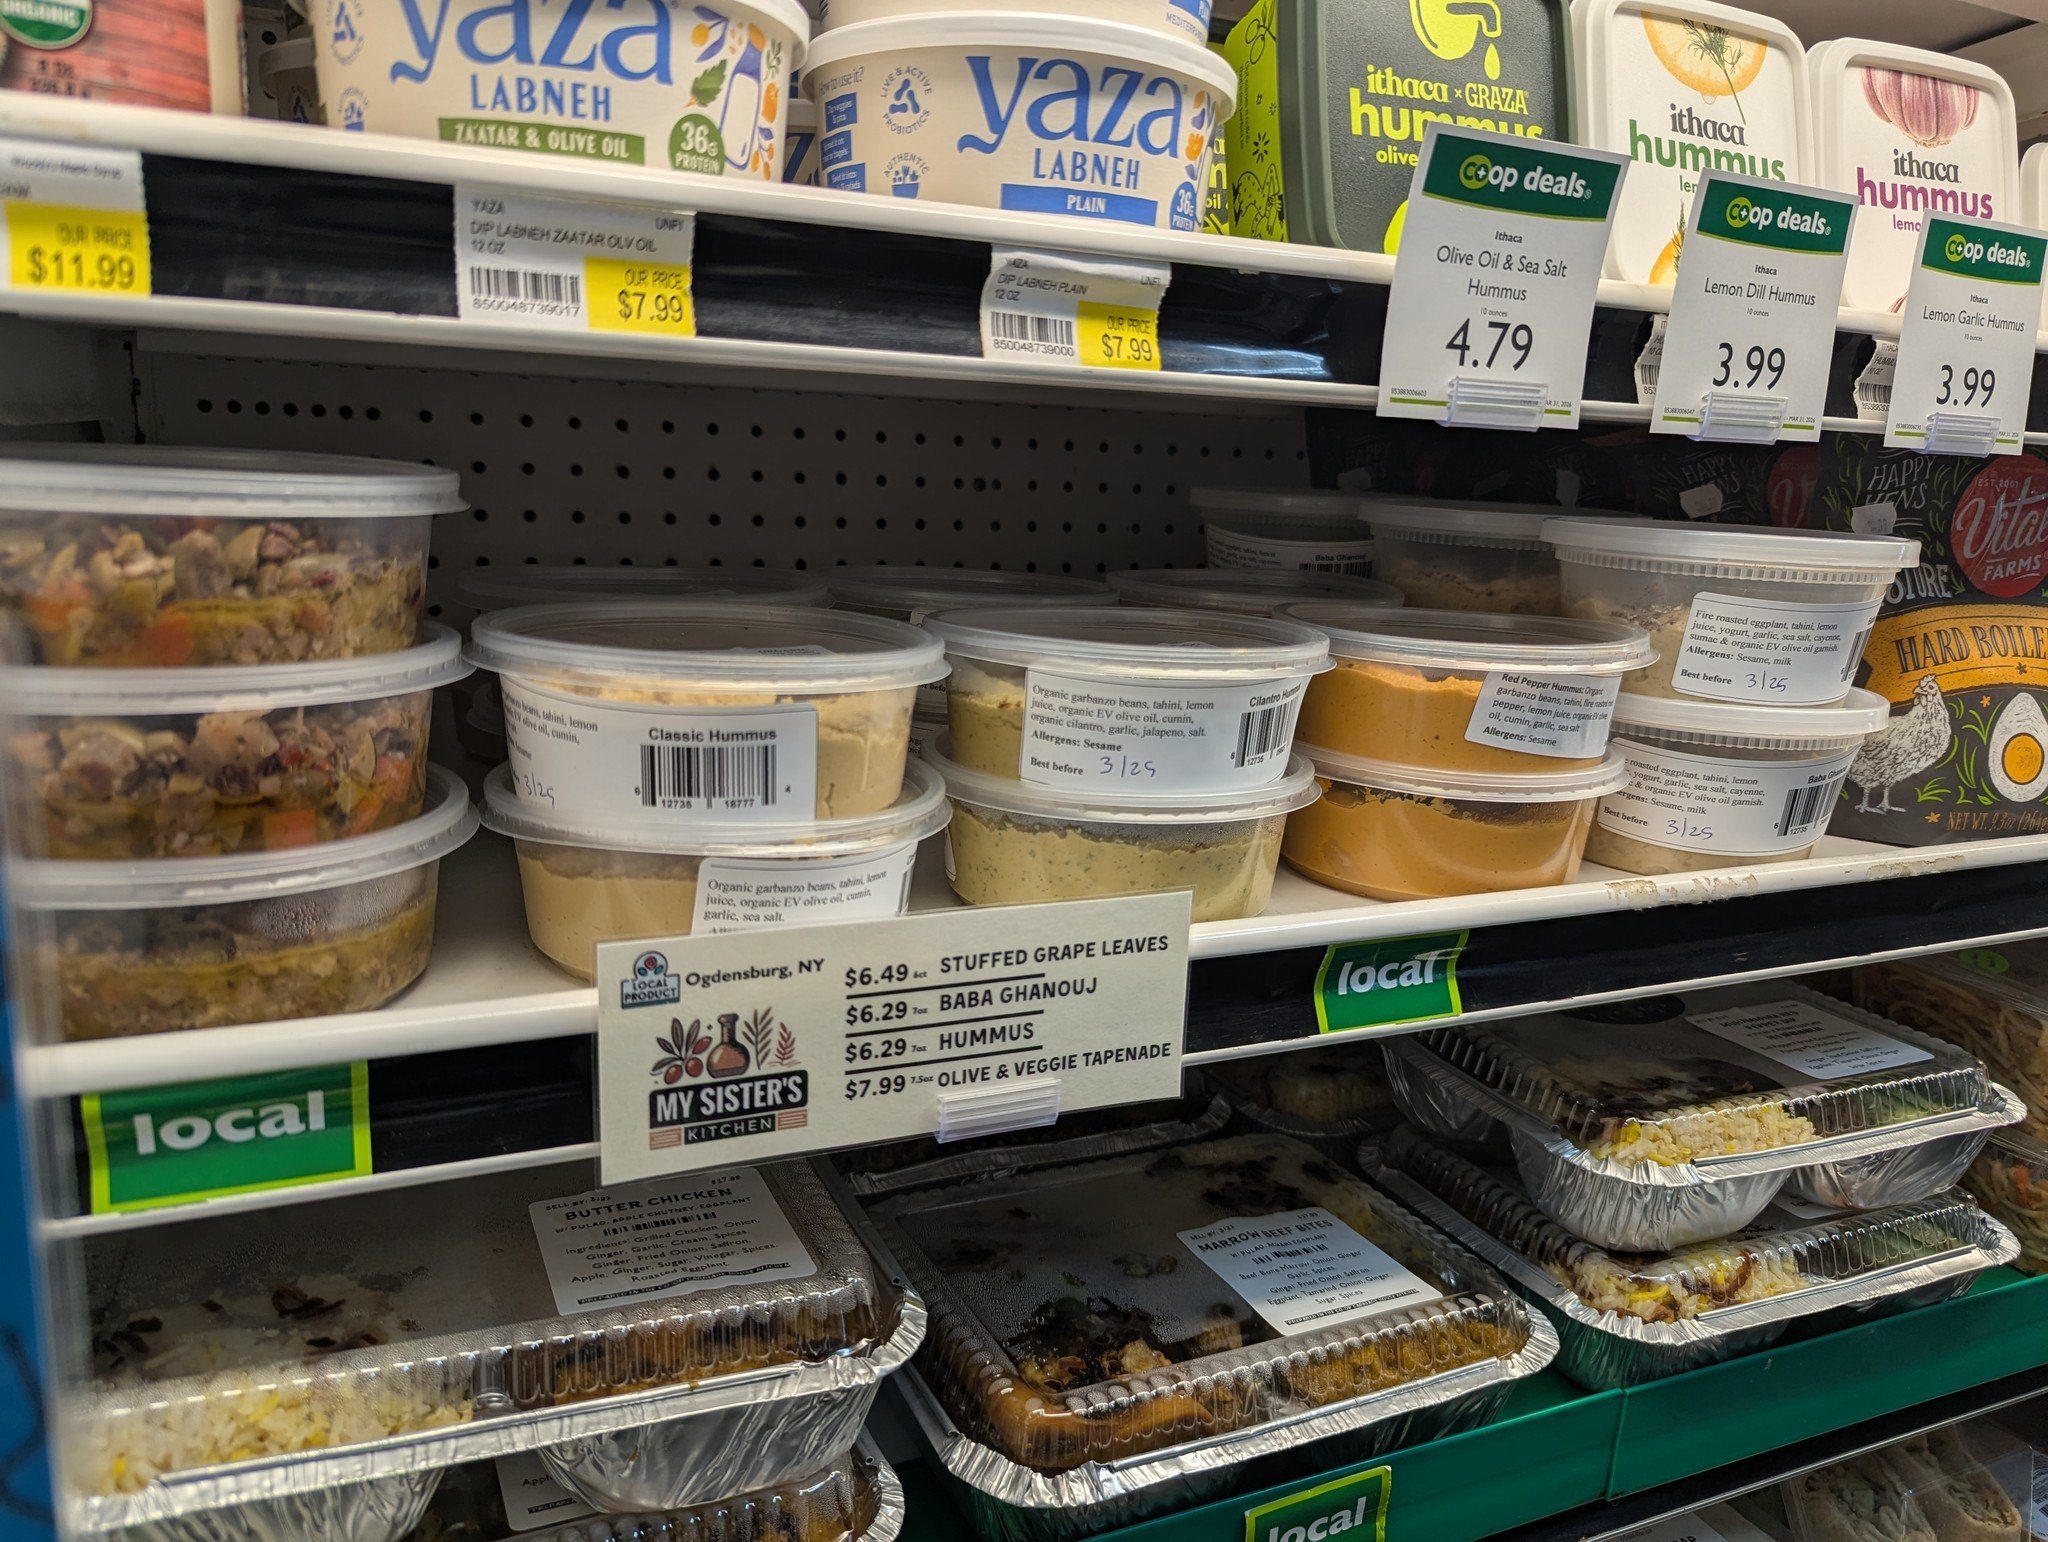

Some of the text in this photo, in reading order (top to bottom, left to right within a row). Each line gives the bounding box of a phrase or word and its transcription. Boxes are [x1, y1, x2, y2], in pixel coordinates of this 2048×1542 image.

[390, 0, 673, 84] yaza
[470, 74, 612, 122] LABNEH
[1367, 64, 1529, 115] ithaca GRAZA
[957, 55, 1184, 160] yaza
[1670, 103, 1745, 146] ithaca
[454, 122, 631, 159] ZA'ATAR & OLIVE OIL
[1629, 119, 1785, 182] hummus
[884, 152, 930, 176] AUTHENTIC
[1034, 147, 1140, 190] LABNEH
[1893, 149, 1959, 183] ithaca
[1067, 195, 1105, 214] PLAIN
[1857, 167, 1993, 219] hummus
[470, 221, 657, 252] DIP LABNEH ZAATAR OLV OIL
[471, 240, 505, 255] 12 OZ
[1495, 230, 1523, 244] Ithaca
[28, 246, 136, 285] $11.99
[1436, 245, 1568, 279] Olive Oil & Sea Salt
[1755, 265, 1777, 276] Ithaca
[625, 269, 683, 290] OUR PRICE
[998, 273, 1089, 295] DIP LABNEH PLAIN
[1467, 279, 1527, 301] Hummus
[1704, 278, 1816, 306] Lemon Dill Hummus
[618, 289, 684, 323] $7.99
[995, 288, 1021, 301] 12 OZ
[1970, 294, 1988, 304] Ithaca
[1107, 315, 1151, 334] OUR PRICE
[1488, 309, 1508, 318] ounces
[1923, 306, 2025, 332] Lemon Garlic Hummus
[1101, 333, 1153, 362] $7.99
[1446, 317, 1533, 371] 4.79
[1713, 342, 1786, 391] 3.99
[1936, 364, 1995, 409] 3.99
[1867, 456, 1937, 490] HAPPY
[1984, 554, 2042, 581] FARMS
[1695, 609, 1838, 631] Fire roasted eggplant, tahini, lemon
[1686, 645, 1792, 666] Allergens: Sesame, milk
[1892, 626, 1971, 674] HARD
[1502, 673, 1585, 694] Red Pepper Hummus:
[1680, 669, 1700, 680] Best
[1702, 673, 1732, 685] before
[1031, 698, 1194, 724] juice, organic EV olive oil, cumin,
[1032, 684, 1214, 711] Organic garbanzo beans, tahini, lemon
[1249, 693, 1281, 708] Cilantro
[648, 728, 777, 743] Classic Hummus
[1031, 712, 1064, 728] organic
[1066, 719, 1106, 733] cilantro,
[1108, 725, 1140, 737] garlic,
[1141, 727, 1186, 739] jalapeno,
[1483, 726, 1557, 746] Allergens: Sesame
[1031, 730, 1122, 752] Allergens: Sesame
[1030, 756, 1050, 769] Best
[1052, 761, 1084, 776] before
[1947, 812, 1969, 832] NET
[686, 958, 825, 988] Ogdensburg, NY
[844, 964, 909, 989] $6.49
[940, 950, 1027, 973] STUFFED
[1034, 942, 1096, 964] GRAPE
[1101, 935, 1169, 956] LEAVES
[1338, 951, 1440, 996] local
[624, 988, 678, 1001] PRODUCT
[632, 979, 669, 991] LOCAL
[845, 1001, 908, 1026] $6.29
[939, 988, 993, 1011] BABA
[1000, 977, 1097, 1004] GHANOUJ
[845, 1038, 907, 1064] $6.29
[939, 1022, 1034, 1050] HUMMUS
[844, 1075, 906, 1101] $7.99
[937, 1067, 991, 1087] OLIVE
[996, 1064, 1009, 1080] &
[1014, 1055, 1078, 1078] VEGGIE
[1082, 1042, 1172, 1067] TAPENADE
[656, 1075, 803, 1122] MY SISTER'S
[133, 1090, 326, 1156] local
[688, 1117, 772, 1141] KITCHEN
[565, 1187, 733, 1220] BUTTER CHICKEN
[1198, 1219, 1333, 1252] MARROW BEEF BITES
